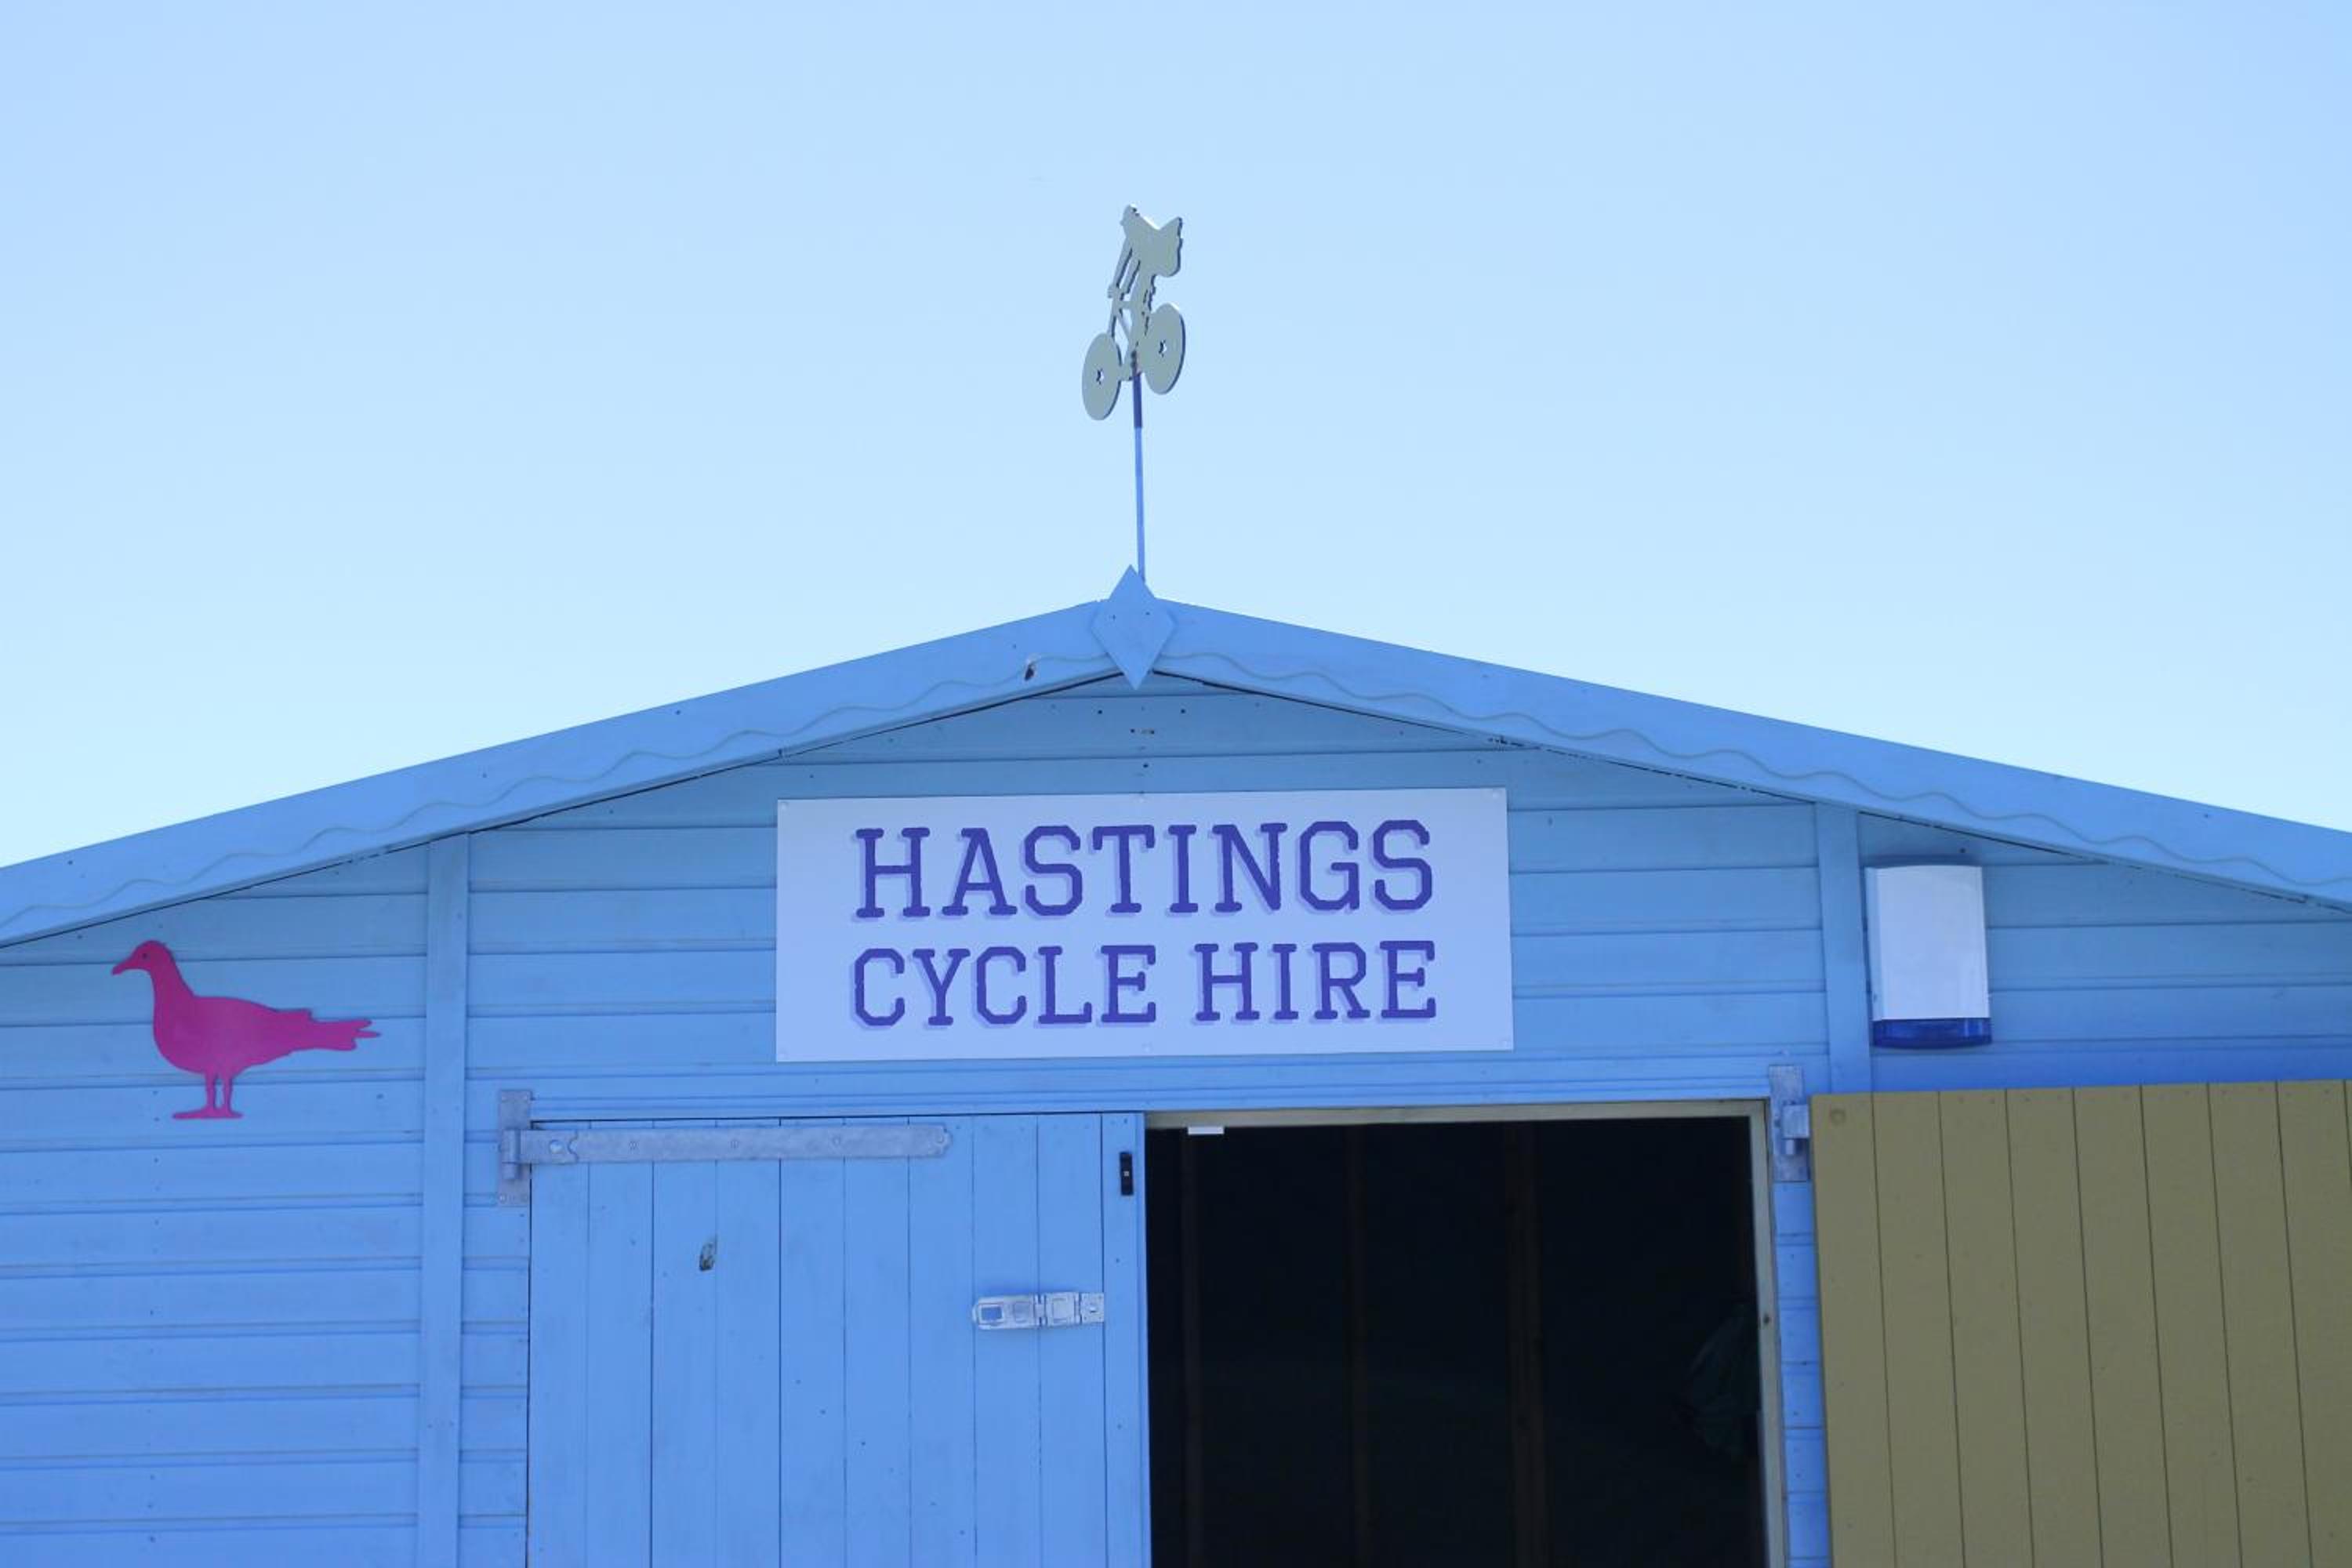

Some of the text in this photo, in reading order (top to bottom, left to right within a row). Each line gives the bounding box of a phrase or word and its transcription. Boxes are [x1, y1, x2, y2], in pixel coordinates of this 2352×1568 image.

[853, 819, 1434, 920] HASTINGS
[851, 940, 1437, 1029] CYCLE HIRE
